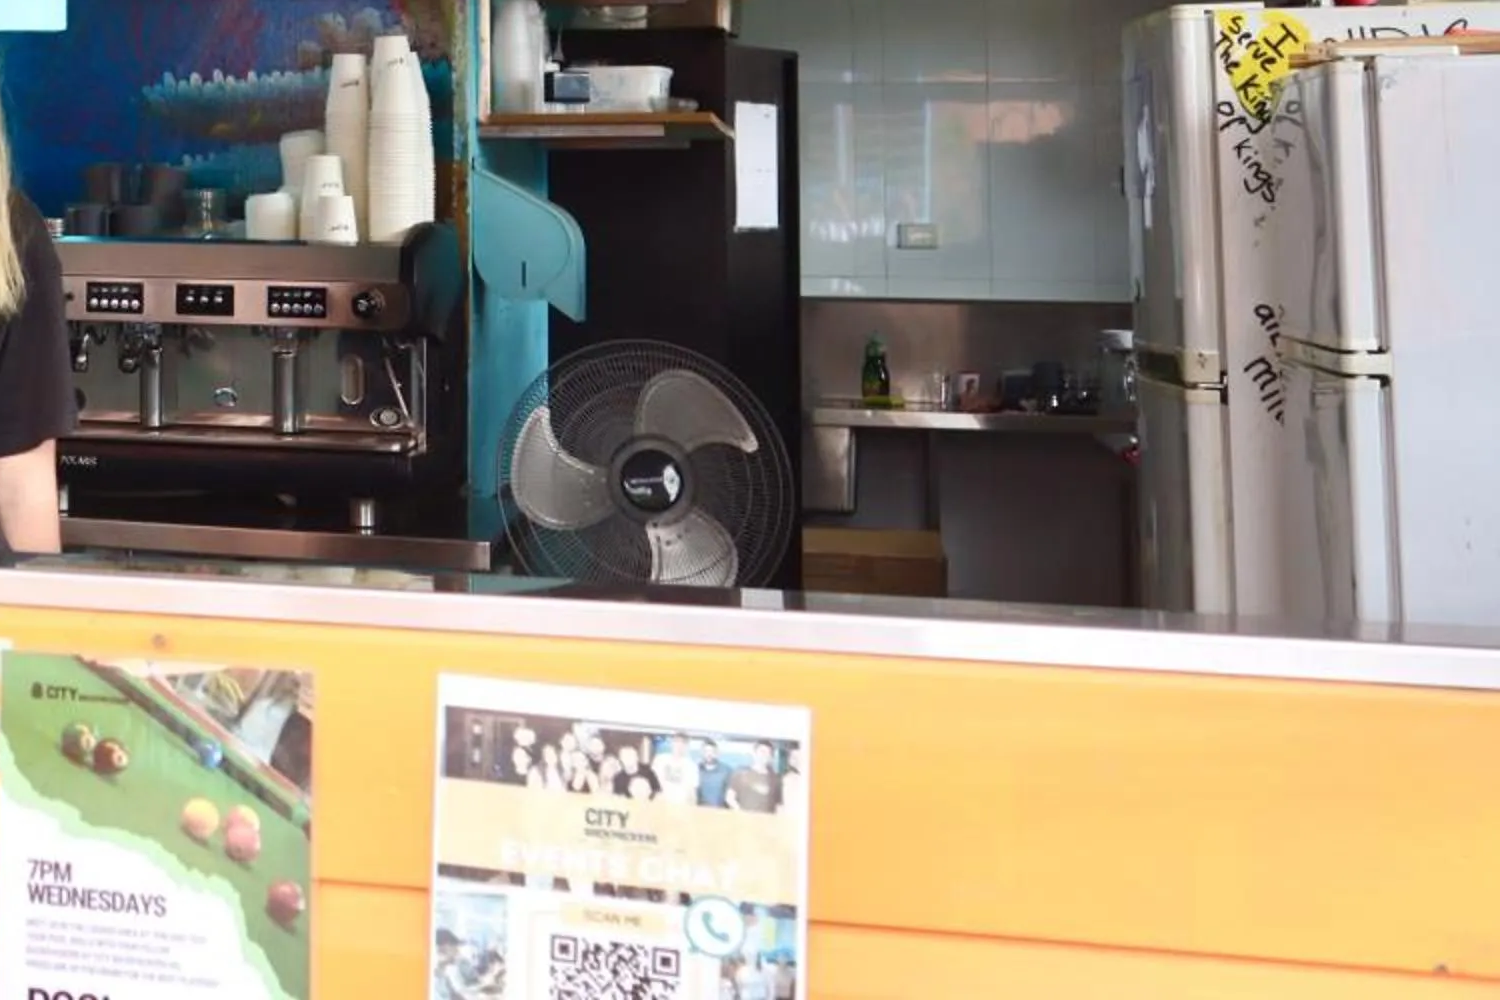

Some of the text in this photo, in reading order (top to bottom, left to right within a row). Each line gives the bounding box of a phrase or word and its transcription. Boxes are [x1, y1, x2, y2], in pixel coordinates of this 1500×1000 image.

[46, 684, 79, 701] CITY
[585, 807, 629, 829] CITY
[26, 859, 73, 883] 7PM
[26, 883, 168, 918] WEDNESDAYS
